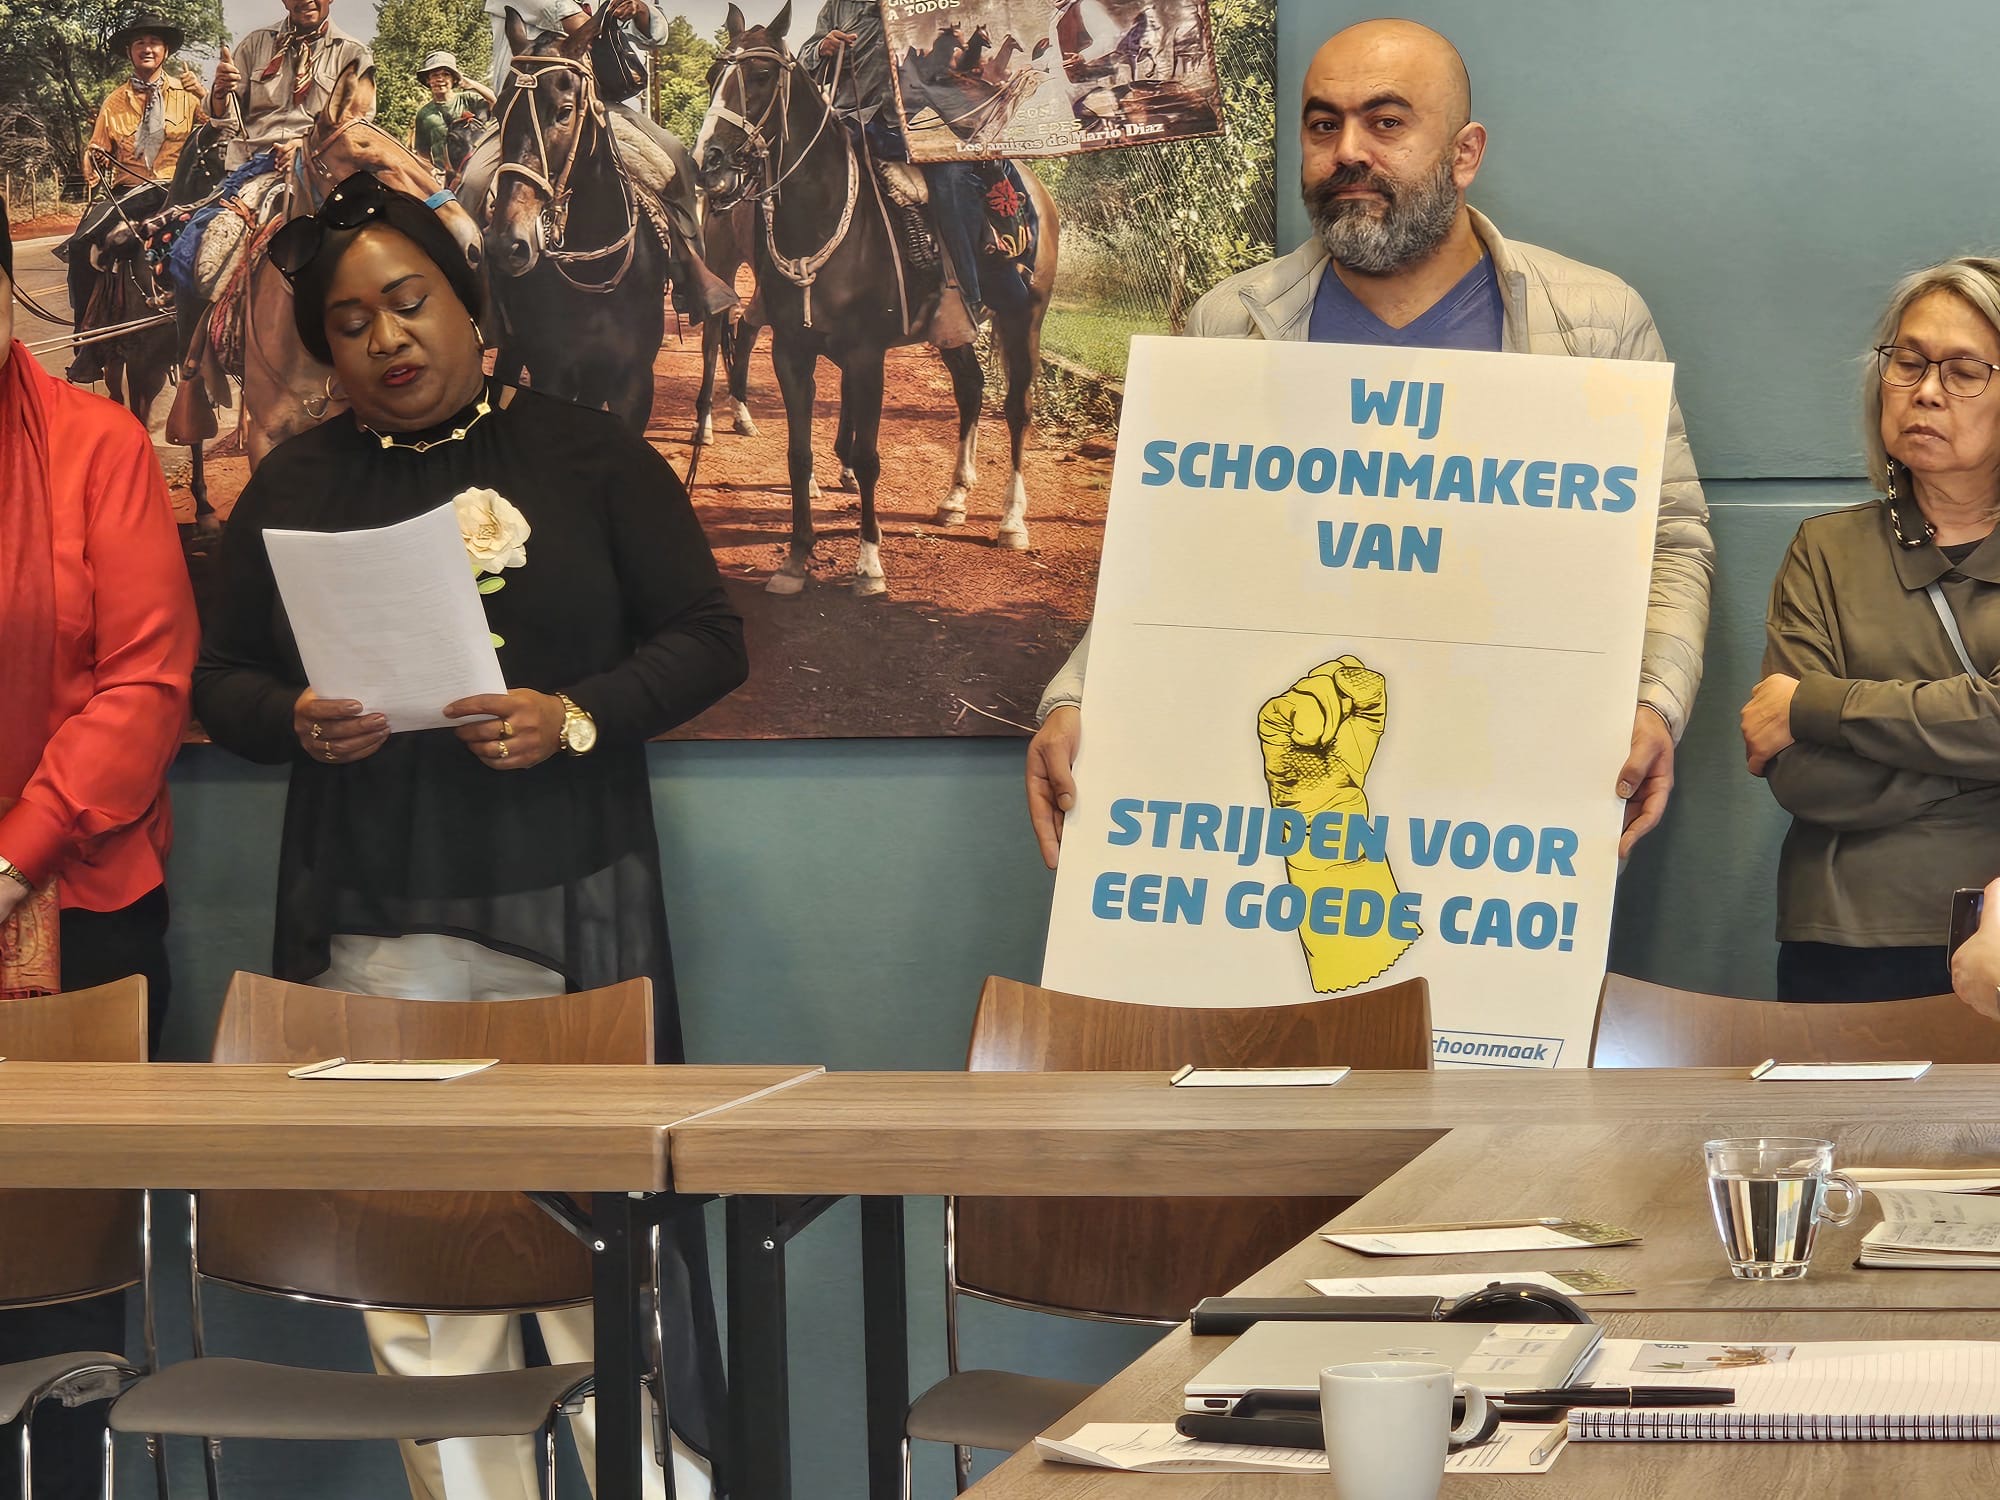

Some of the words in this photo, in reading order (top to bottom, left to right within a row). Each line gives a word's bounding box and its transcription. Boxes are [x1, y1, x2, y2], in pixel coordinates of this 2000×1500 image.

[955, 142, 984, 152] Los
[986, 138, 1043, 151] amigos
[1046, 134, 1068, 147] de
[1071, 126, 1123, 144] Mario
[1123, 123, 1165, 137] Diaz
[1351, 379, 1443, 438] WIJ
[1142, 440, 1638, 512] SCHOONMAKERS
[1317, 521, 1442, 572] VAN
[1107, 798, 1389, 866] STRIJDEN
[1409, 818, 1579, 877] VOOR
[1091, 872, 1207, 926] EEN
[1224, 881, 1421, 941] GOEDE
[1439, 895, 1578, 952] CAO!
[1432, 1036, 1548, 1061] hoonmaak
